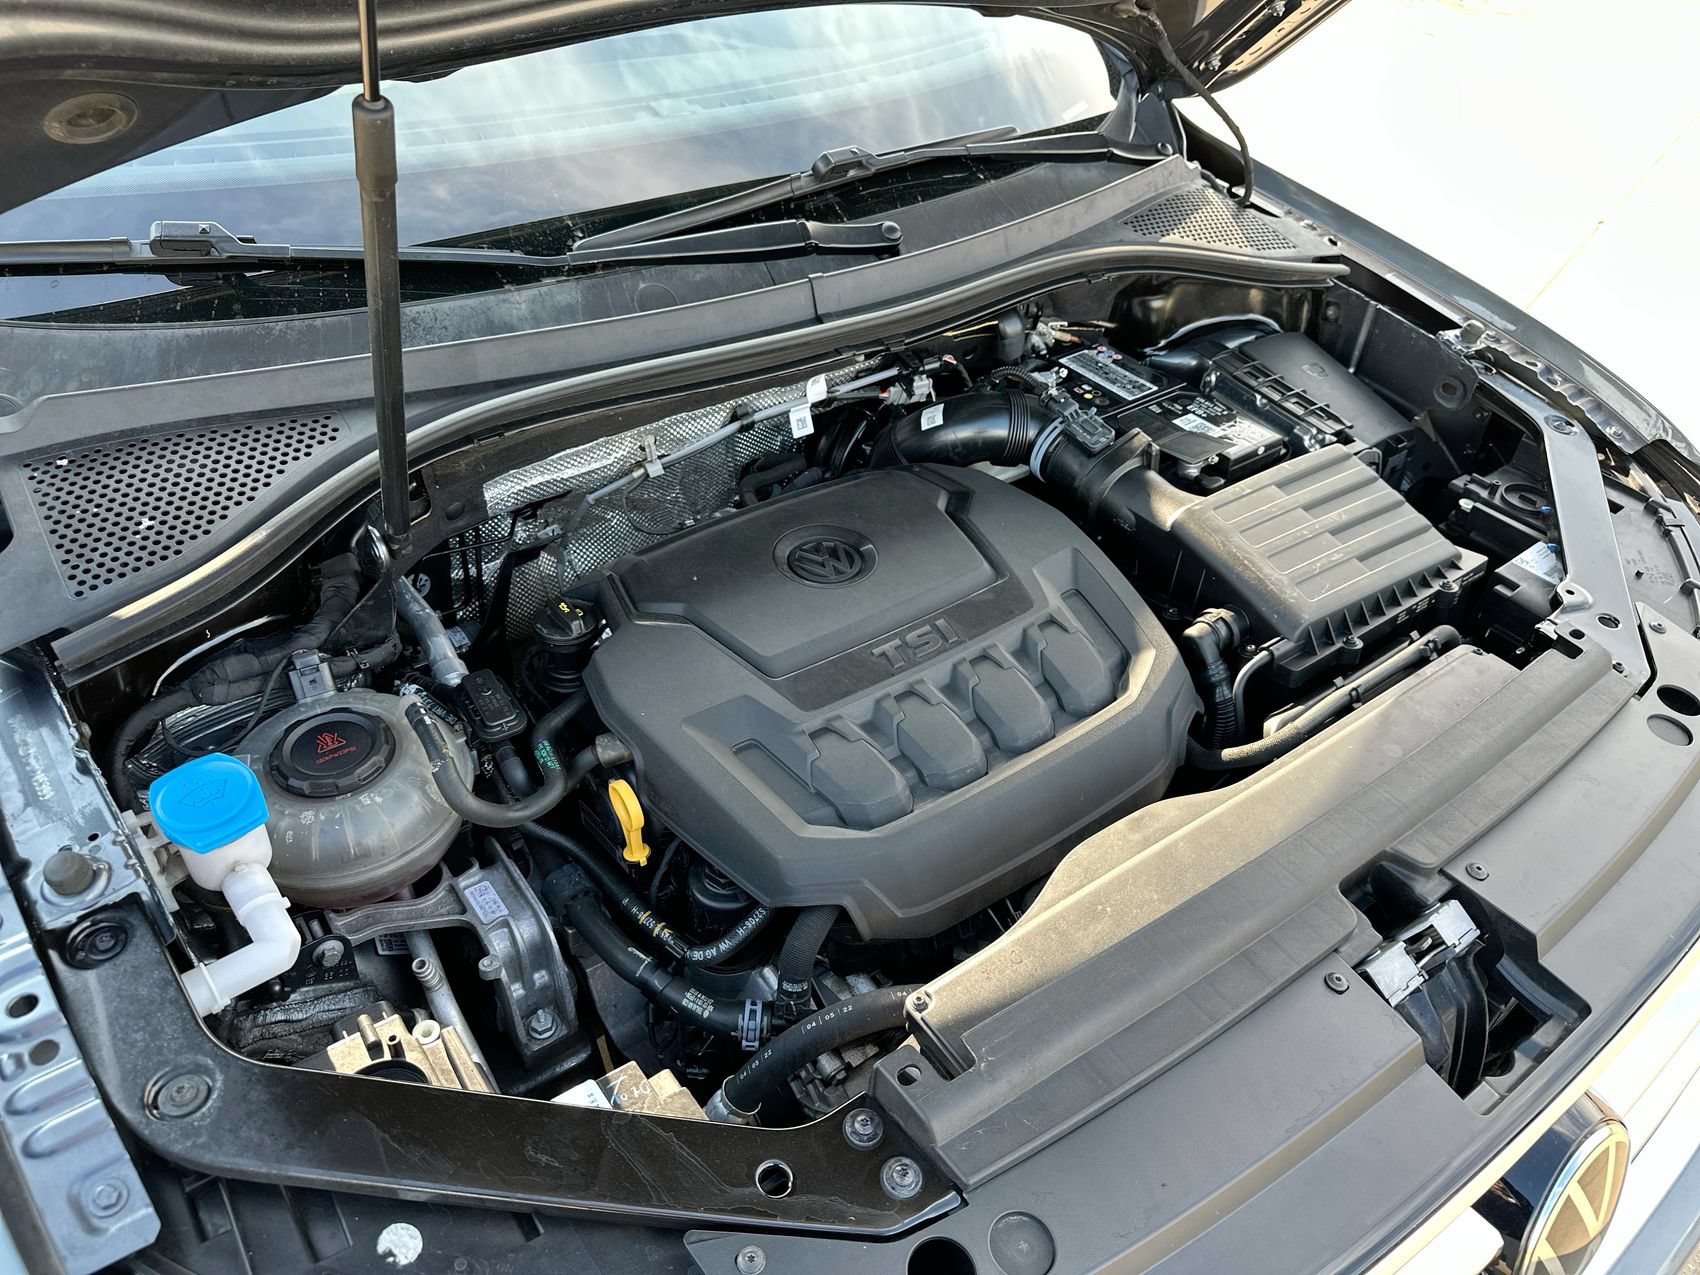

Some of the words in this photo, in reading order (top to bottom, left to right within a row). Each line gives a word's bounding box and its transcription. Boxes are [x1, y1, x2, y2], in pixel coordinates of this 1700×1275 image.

[789, 538, 858, 582] VW
[872, 618, 959, 669] TSI
[706, 947, 718, 959] AG
[719, 939, 732, 953] VW
[692, 950, 704, 961] DE
